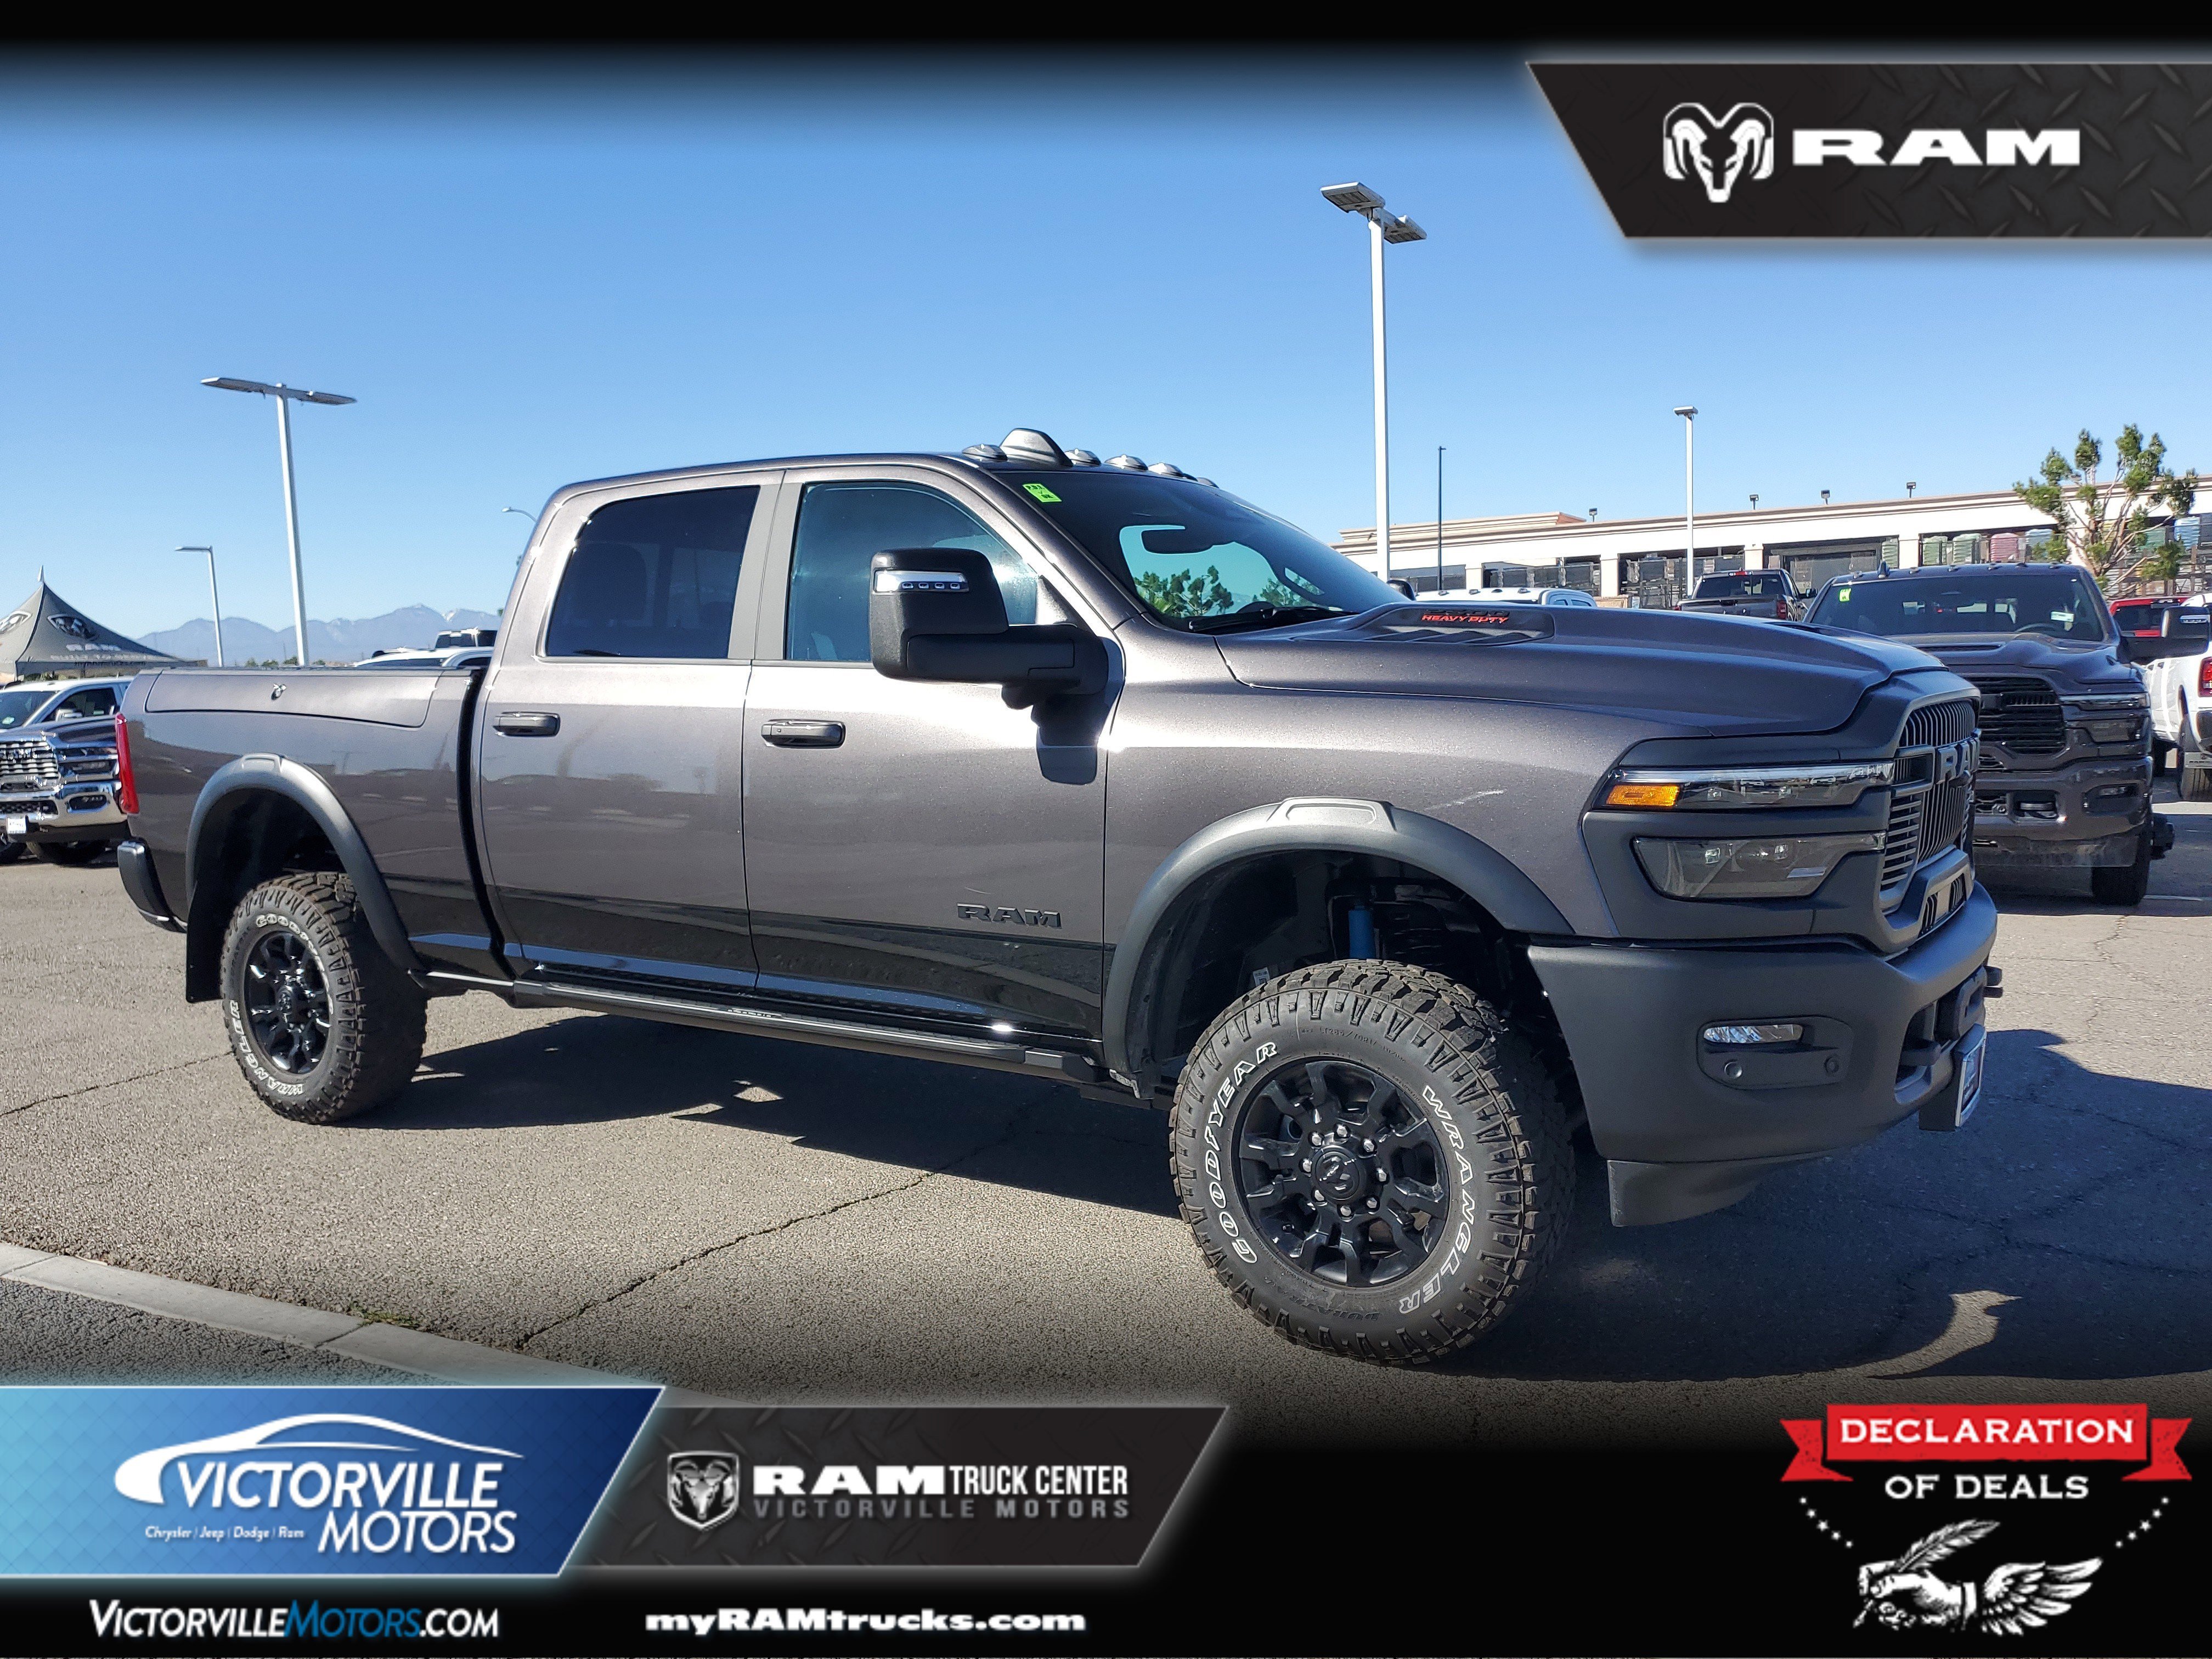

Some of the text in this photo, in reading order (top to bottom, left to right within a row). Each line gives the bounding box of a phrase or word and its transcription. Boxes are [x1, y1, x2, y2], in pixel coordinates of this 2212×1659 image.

[1421, 614, 1509, 624] HEAVY DUTY
[957, 902, 1062, 929] RAM
[1204, 1041, 1277, 1263] GOODYEAR
[1399, 1085, 1475, 1314] WRANGLER
